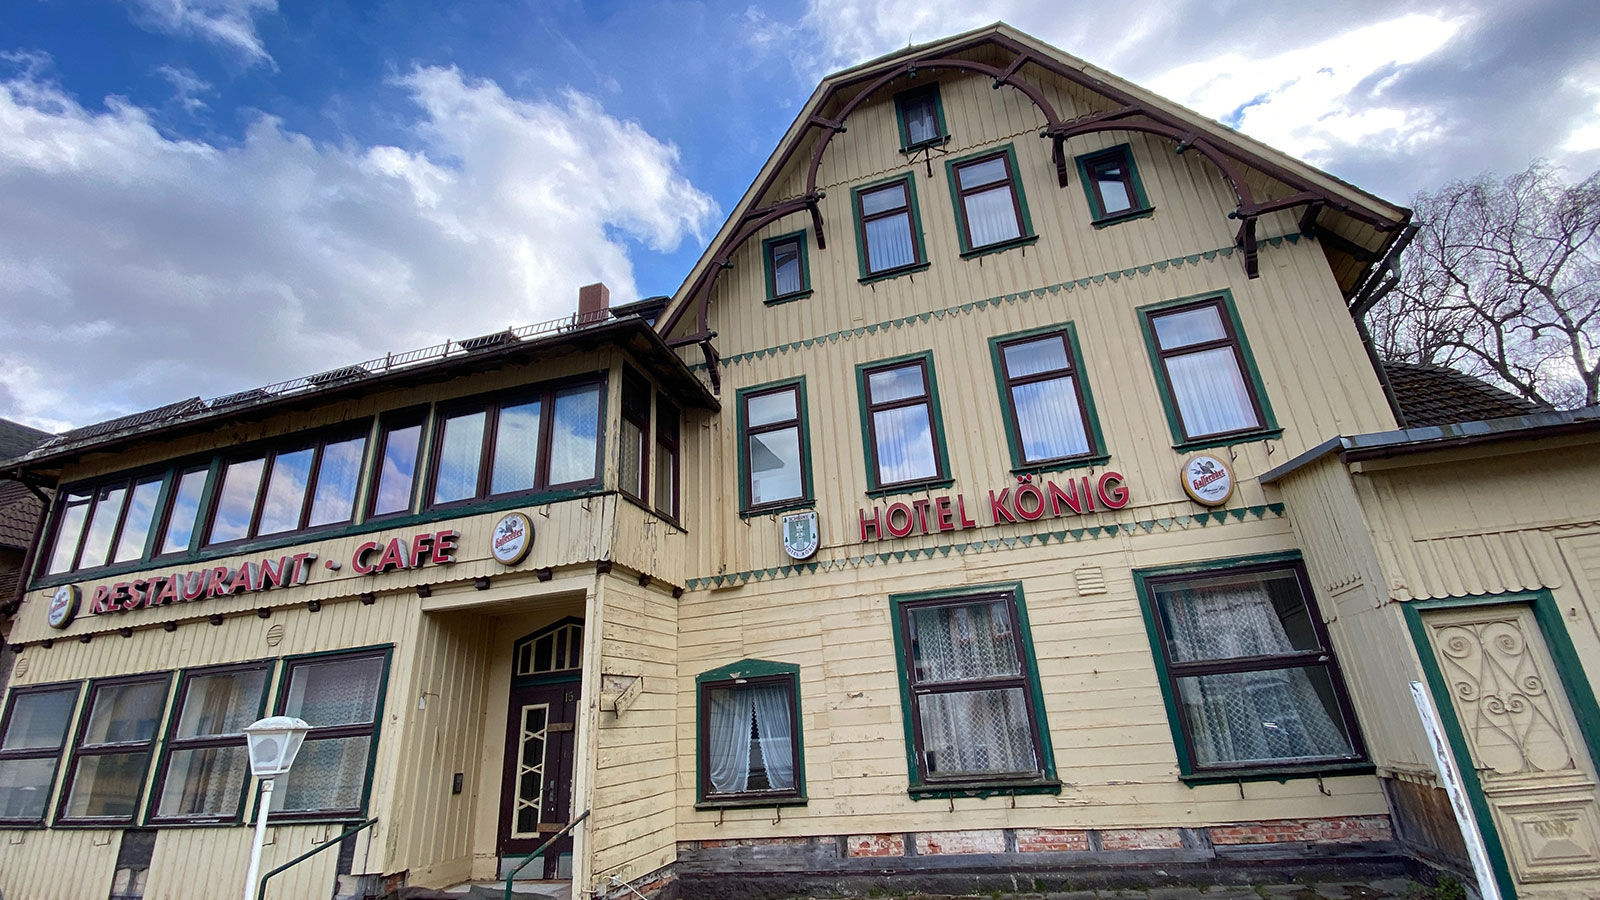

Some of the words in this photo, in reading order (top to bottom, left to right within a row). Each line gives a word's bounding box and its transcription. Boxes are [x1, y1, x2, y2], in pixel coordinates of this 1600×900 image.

[858, 493, 976, 542] HOTEL
[988, 473, 1131, 527] KÖNIG
[89, 552, 318, 615] RESTAURANT
[351, 529, 461, 575] CAFE
[564, 690, 575, 703] 15
